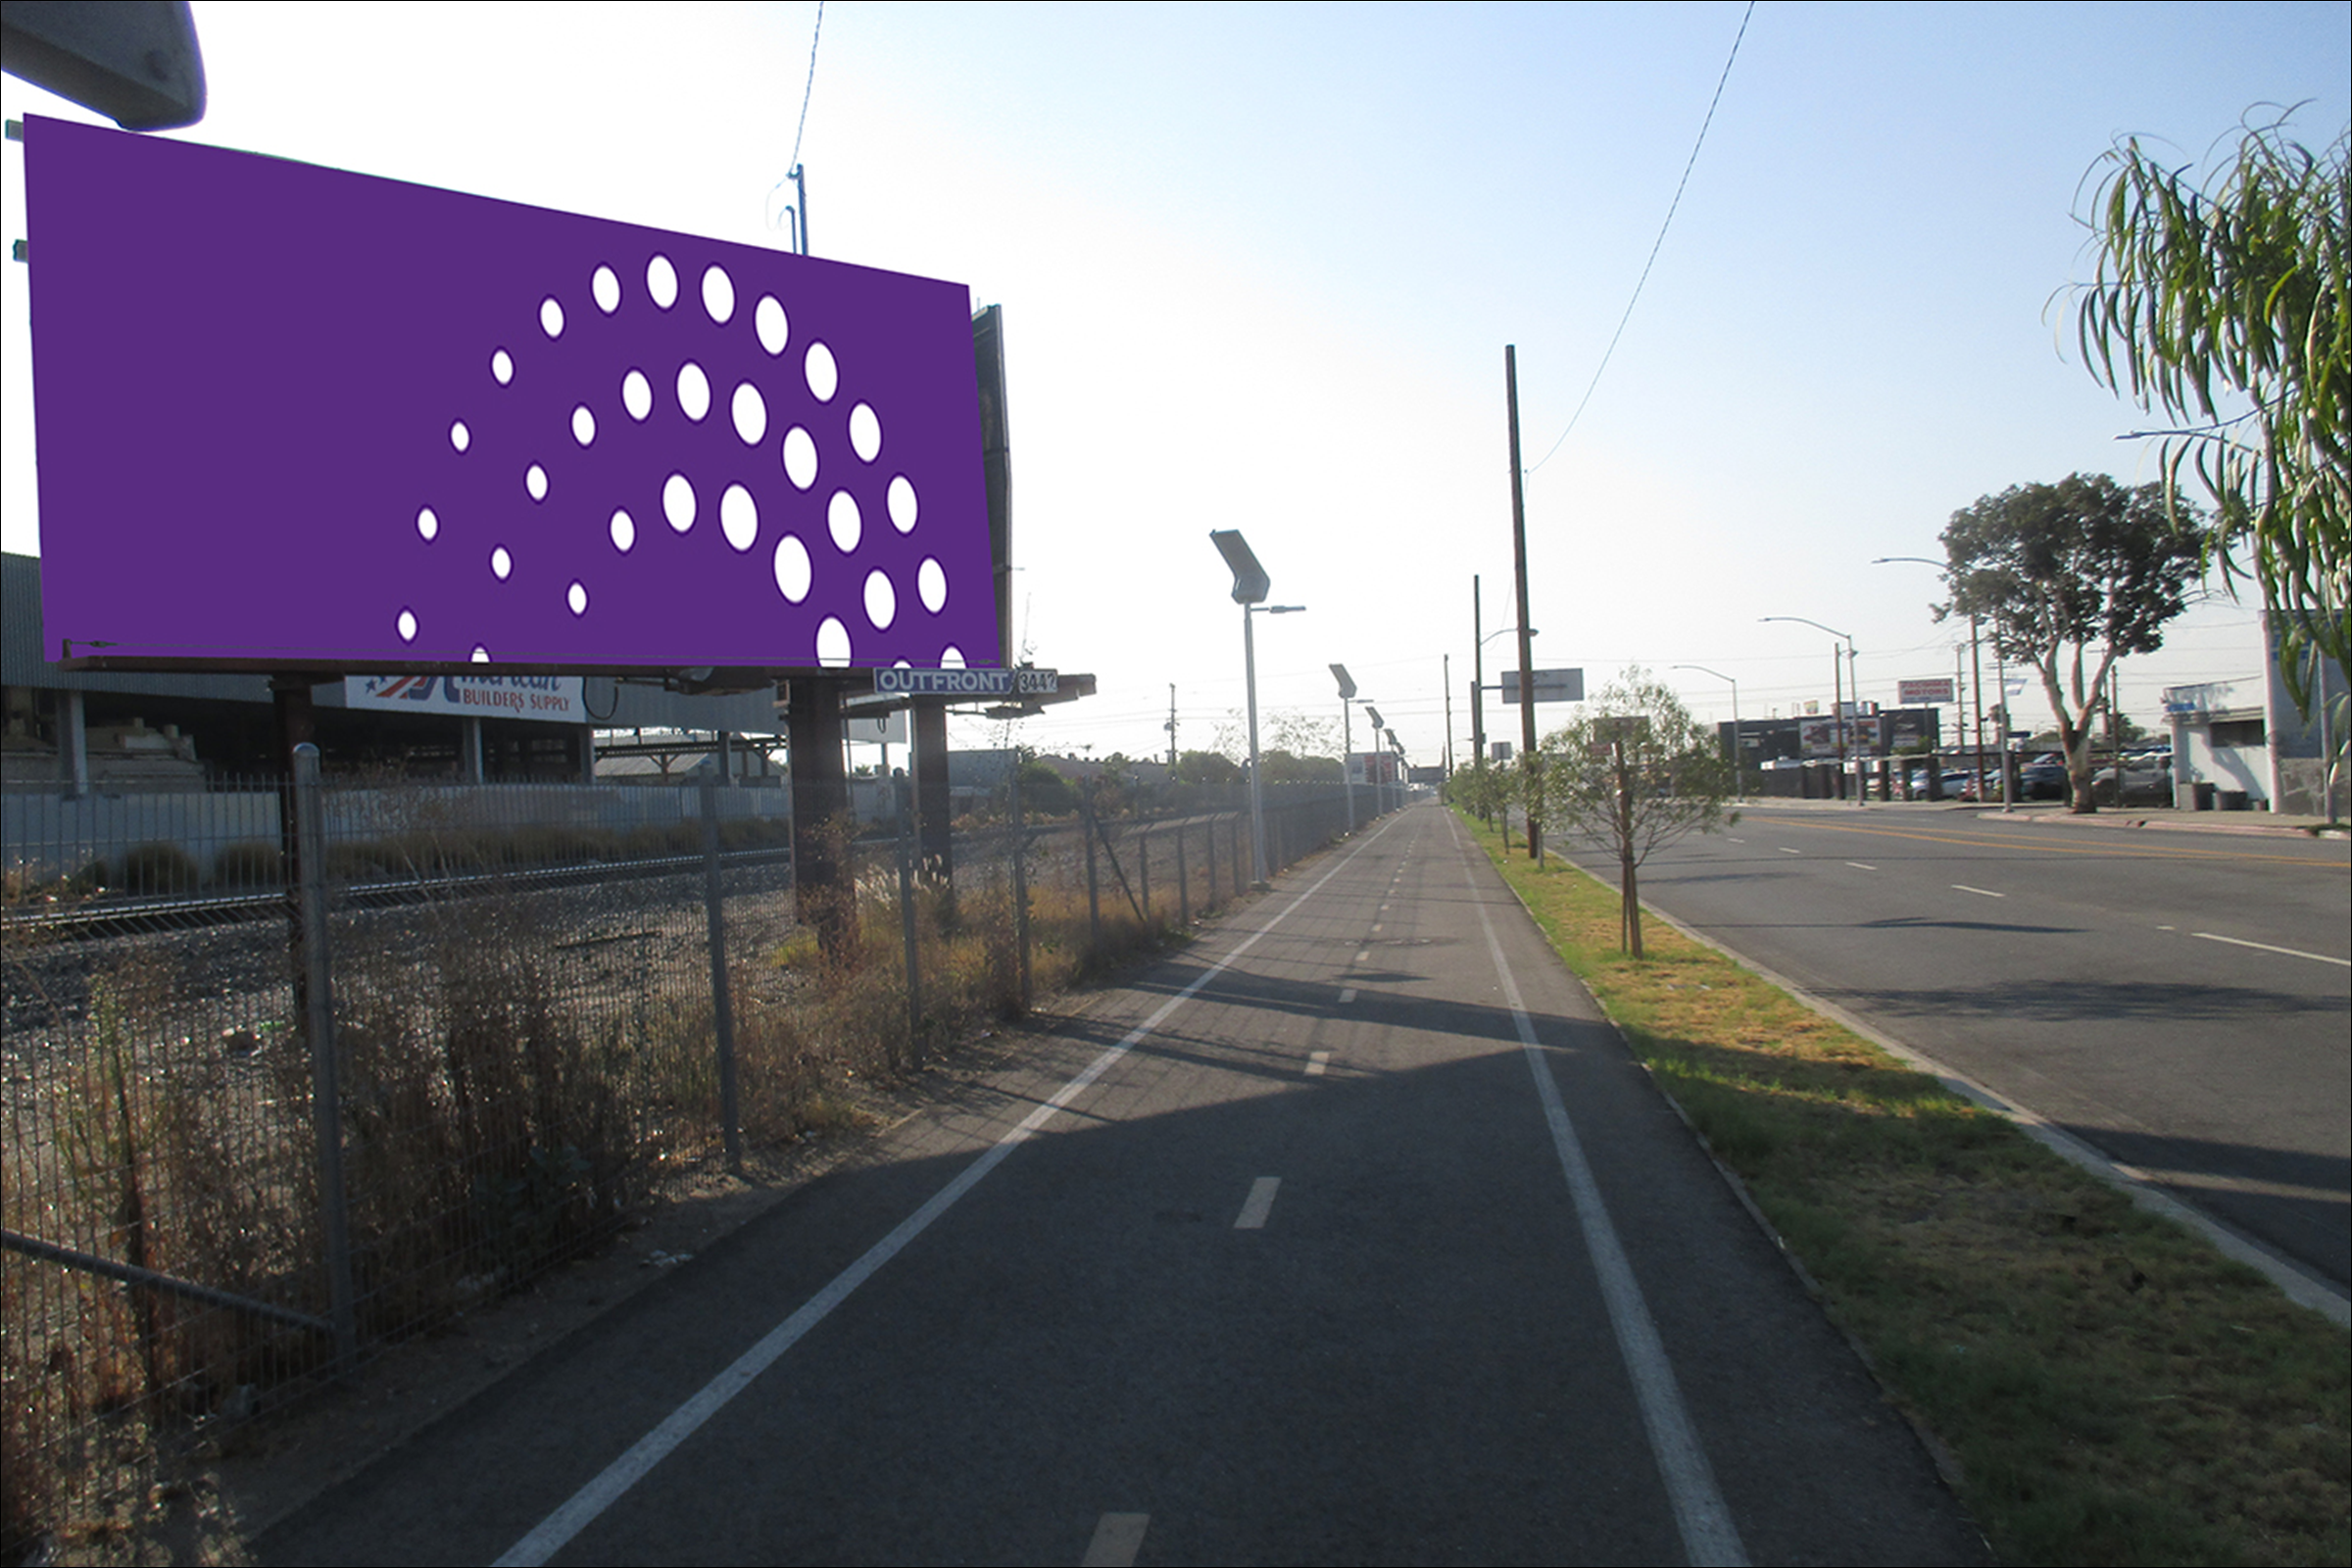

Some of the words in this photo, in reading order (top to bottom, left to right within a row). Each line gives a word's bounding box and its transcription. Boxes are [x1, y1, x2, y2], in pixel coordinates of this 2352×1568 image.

[880, 670, 1009, 691] OUTFRONT
[1019, 672, 1057, 691] 3442
[464, 689, 525, 713] BUILDERS
[530, 693, 570, 712] SUPPLY
